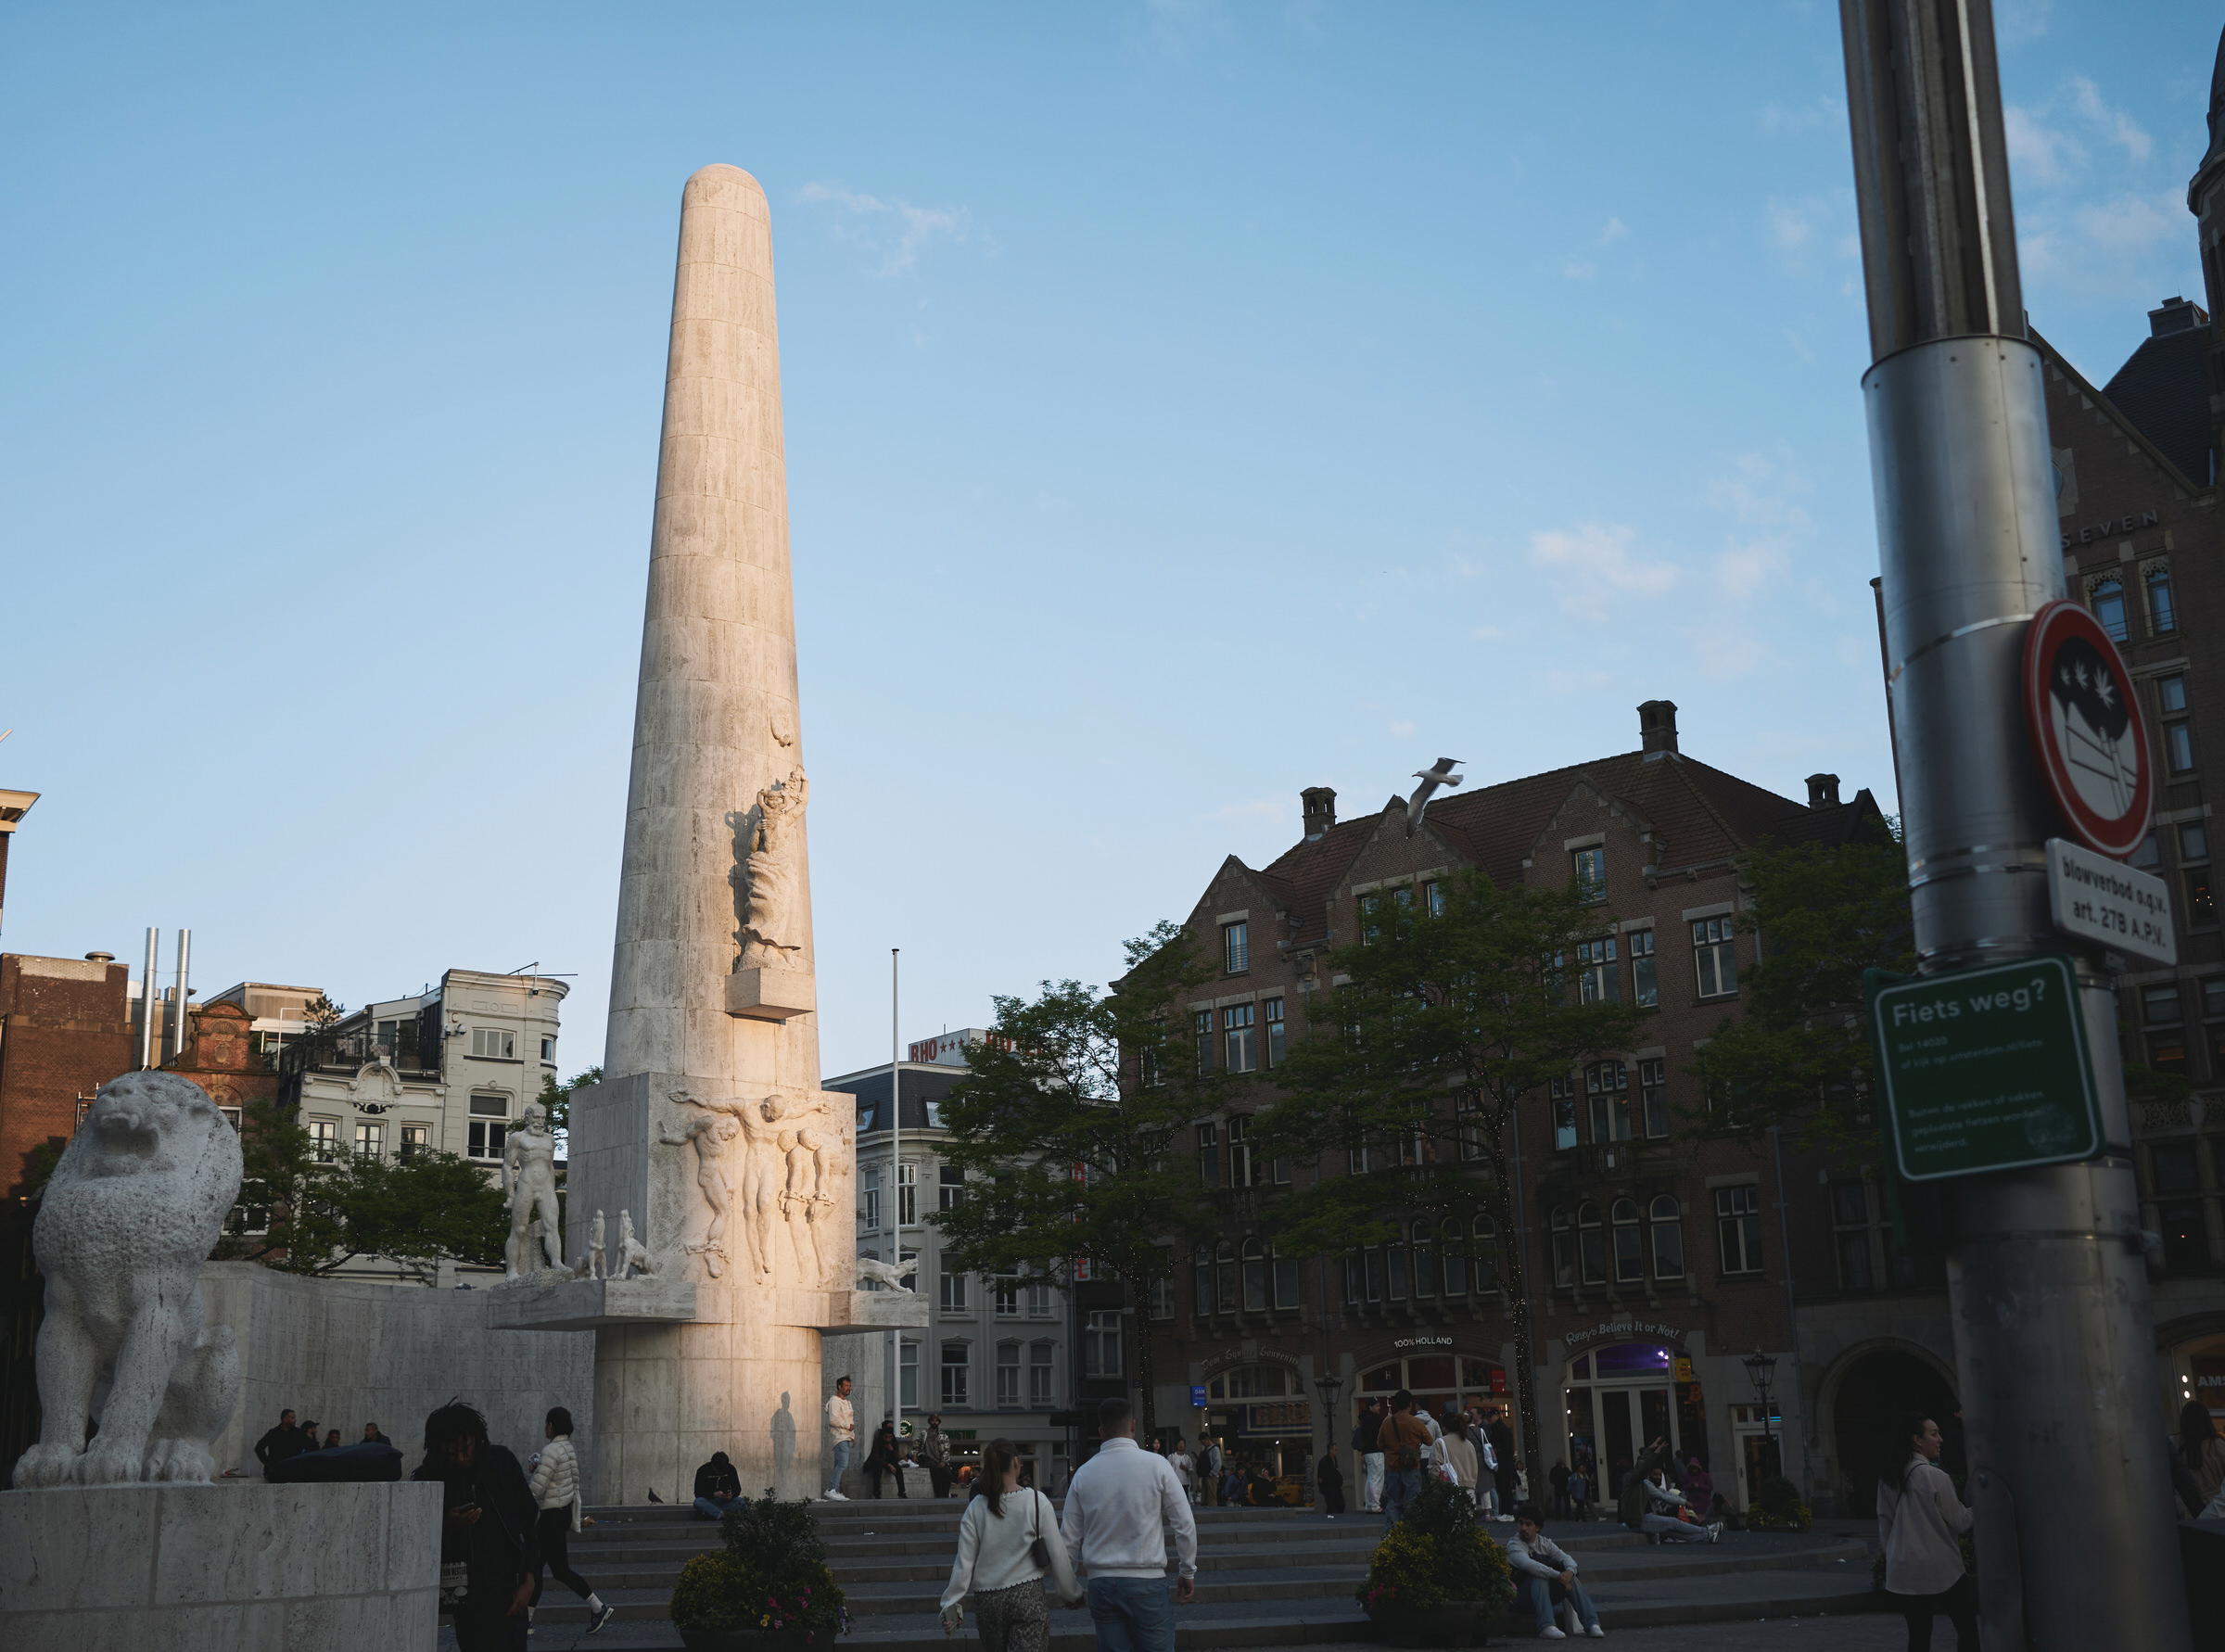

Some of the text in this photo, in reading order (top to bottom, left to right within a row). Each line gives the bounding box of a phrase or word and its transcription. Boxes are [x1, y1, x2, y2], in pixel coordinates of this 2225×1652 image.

[2062, 509, 2159, 549] SEVEN
[2062, 856, 2133, 901] blowverbod
[2073, 901, 2098, 923] art.
[1892, 978, 2046, 1027] Fiets weg?
[910, 1039, 937, 1063] RHO
[1599, 1322, 1632, 1335] Believe
[1634, 1320, 1644, 1332] It
[1645, 1324, 1656, 1333] or
[1657, 1324, 1681, 1340] Not!
